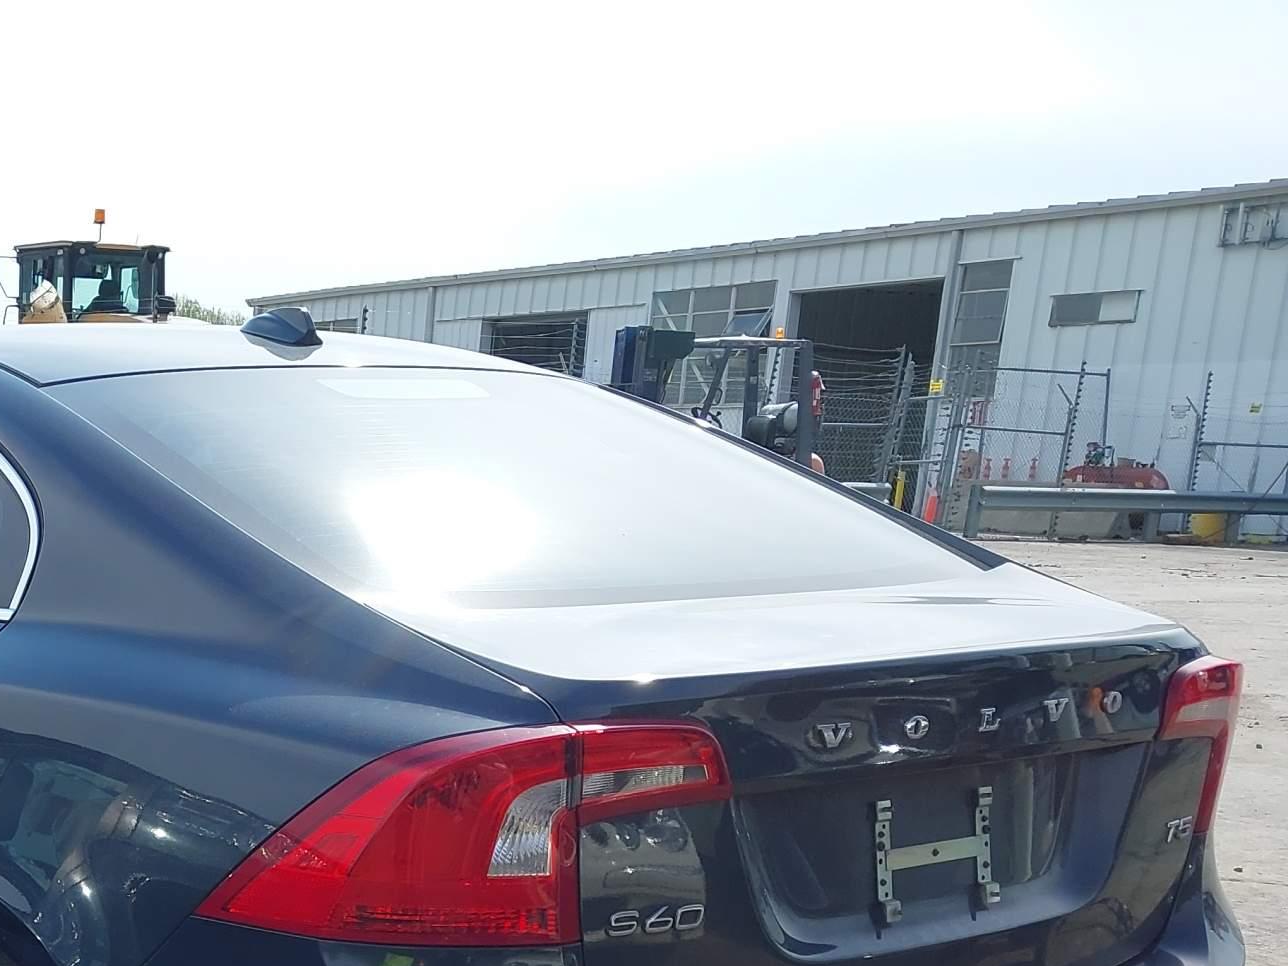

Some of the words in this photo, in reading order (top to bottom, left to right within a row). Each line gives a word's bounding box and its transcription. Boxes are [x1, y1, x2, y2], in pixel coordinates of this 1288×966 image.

[817, 690, 1123, 748] VOLVO
[1167, 815, 1193, 843] T5
[607, 903, 705, 937] S60
